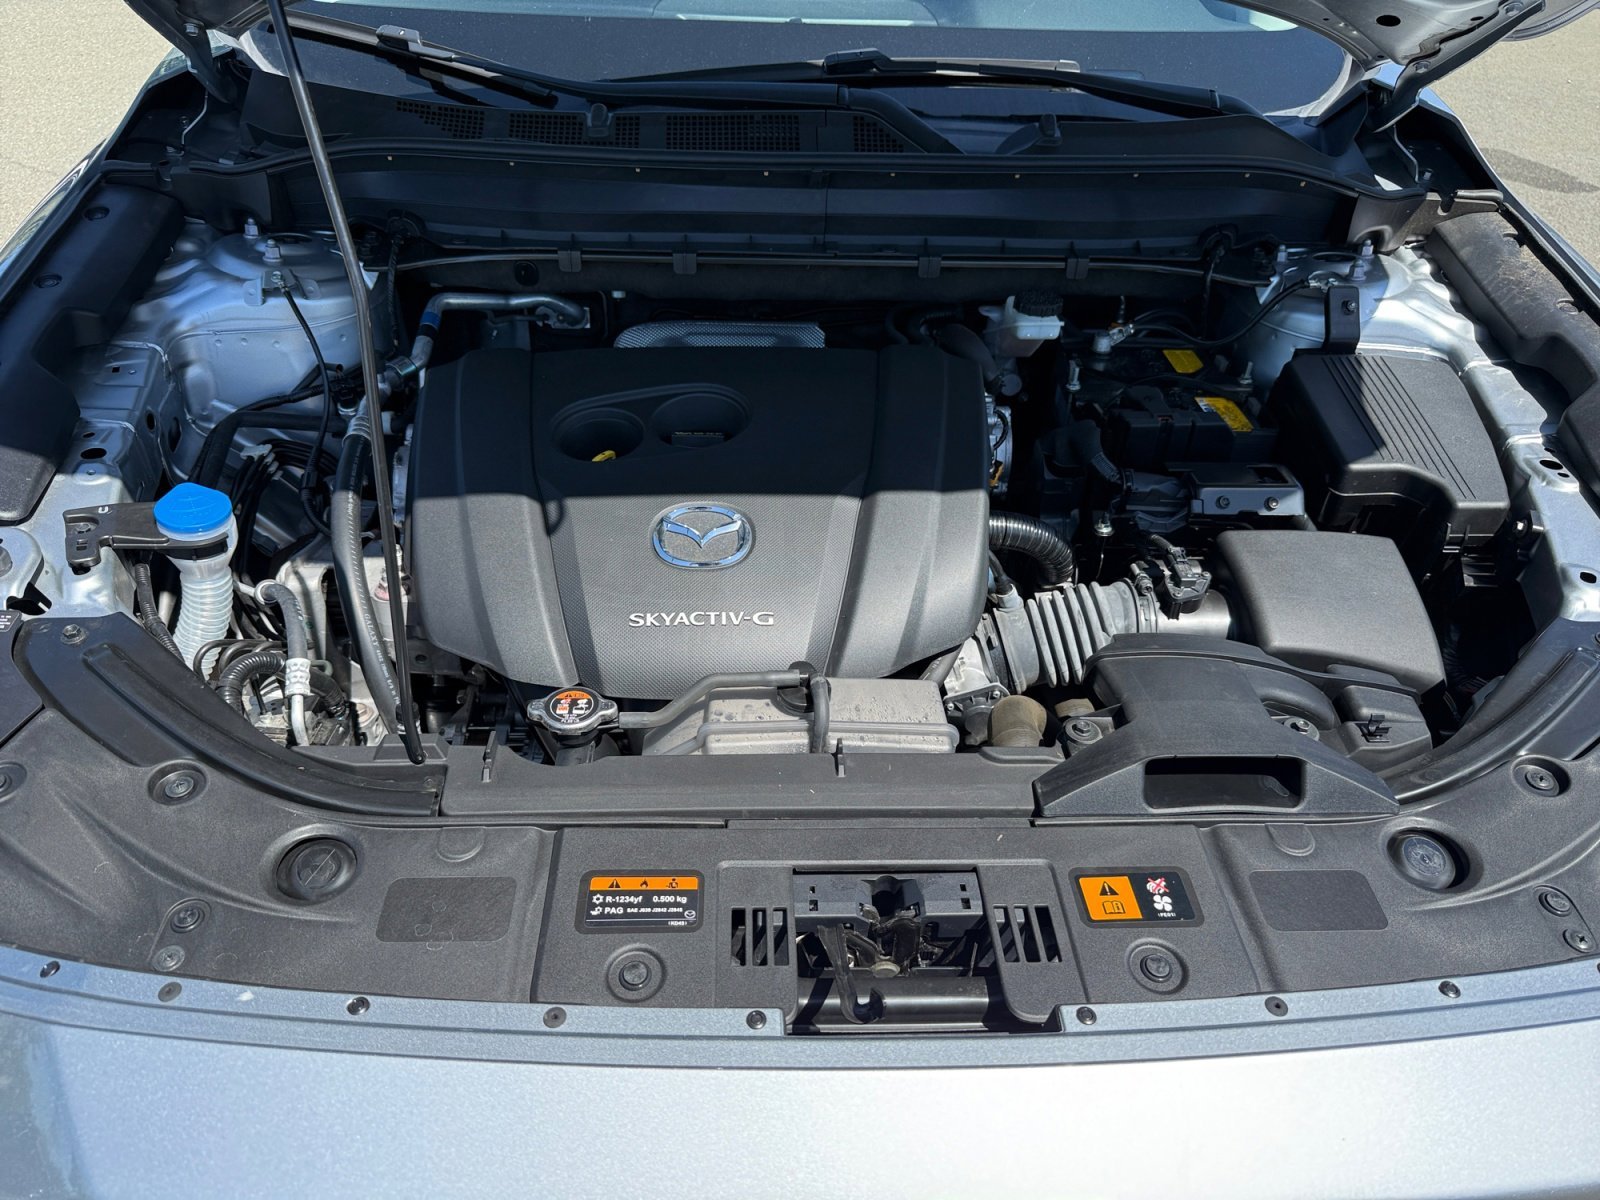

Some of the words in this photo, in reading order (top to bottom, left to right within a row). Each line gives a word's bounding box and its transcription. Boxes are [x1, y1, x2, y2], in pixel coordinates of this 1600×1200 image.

[628, 611, 775, 627] SKYACTIV-G
[364, 613, 379, 647] GALAXY
[606, 896, 643, 904] R-1234yf
[676, 896, 688, 904] kg
